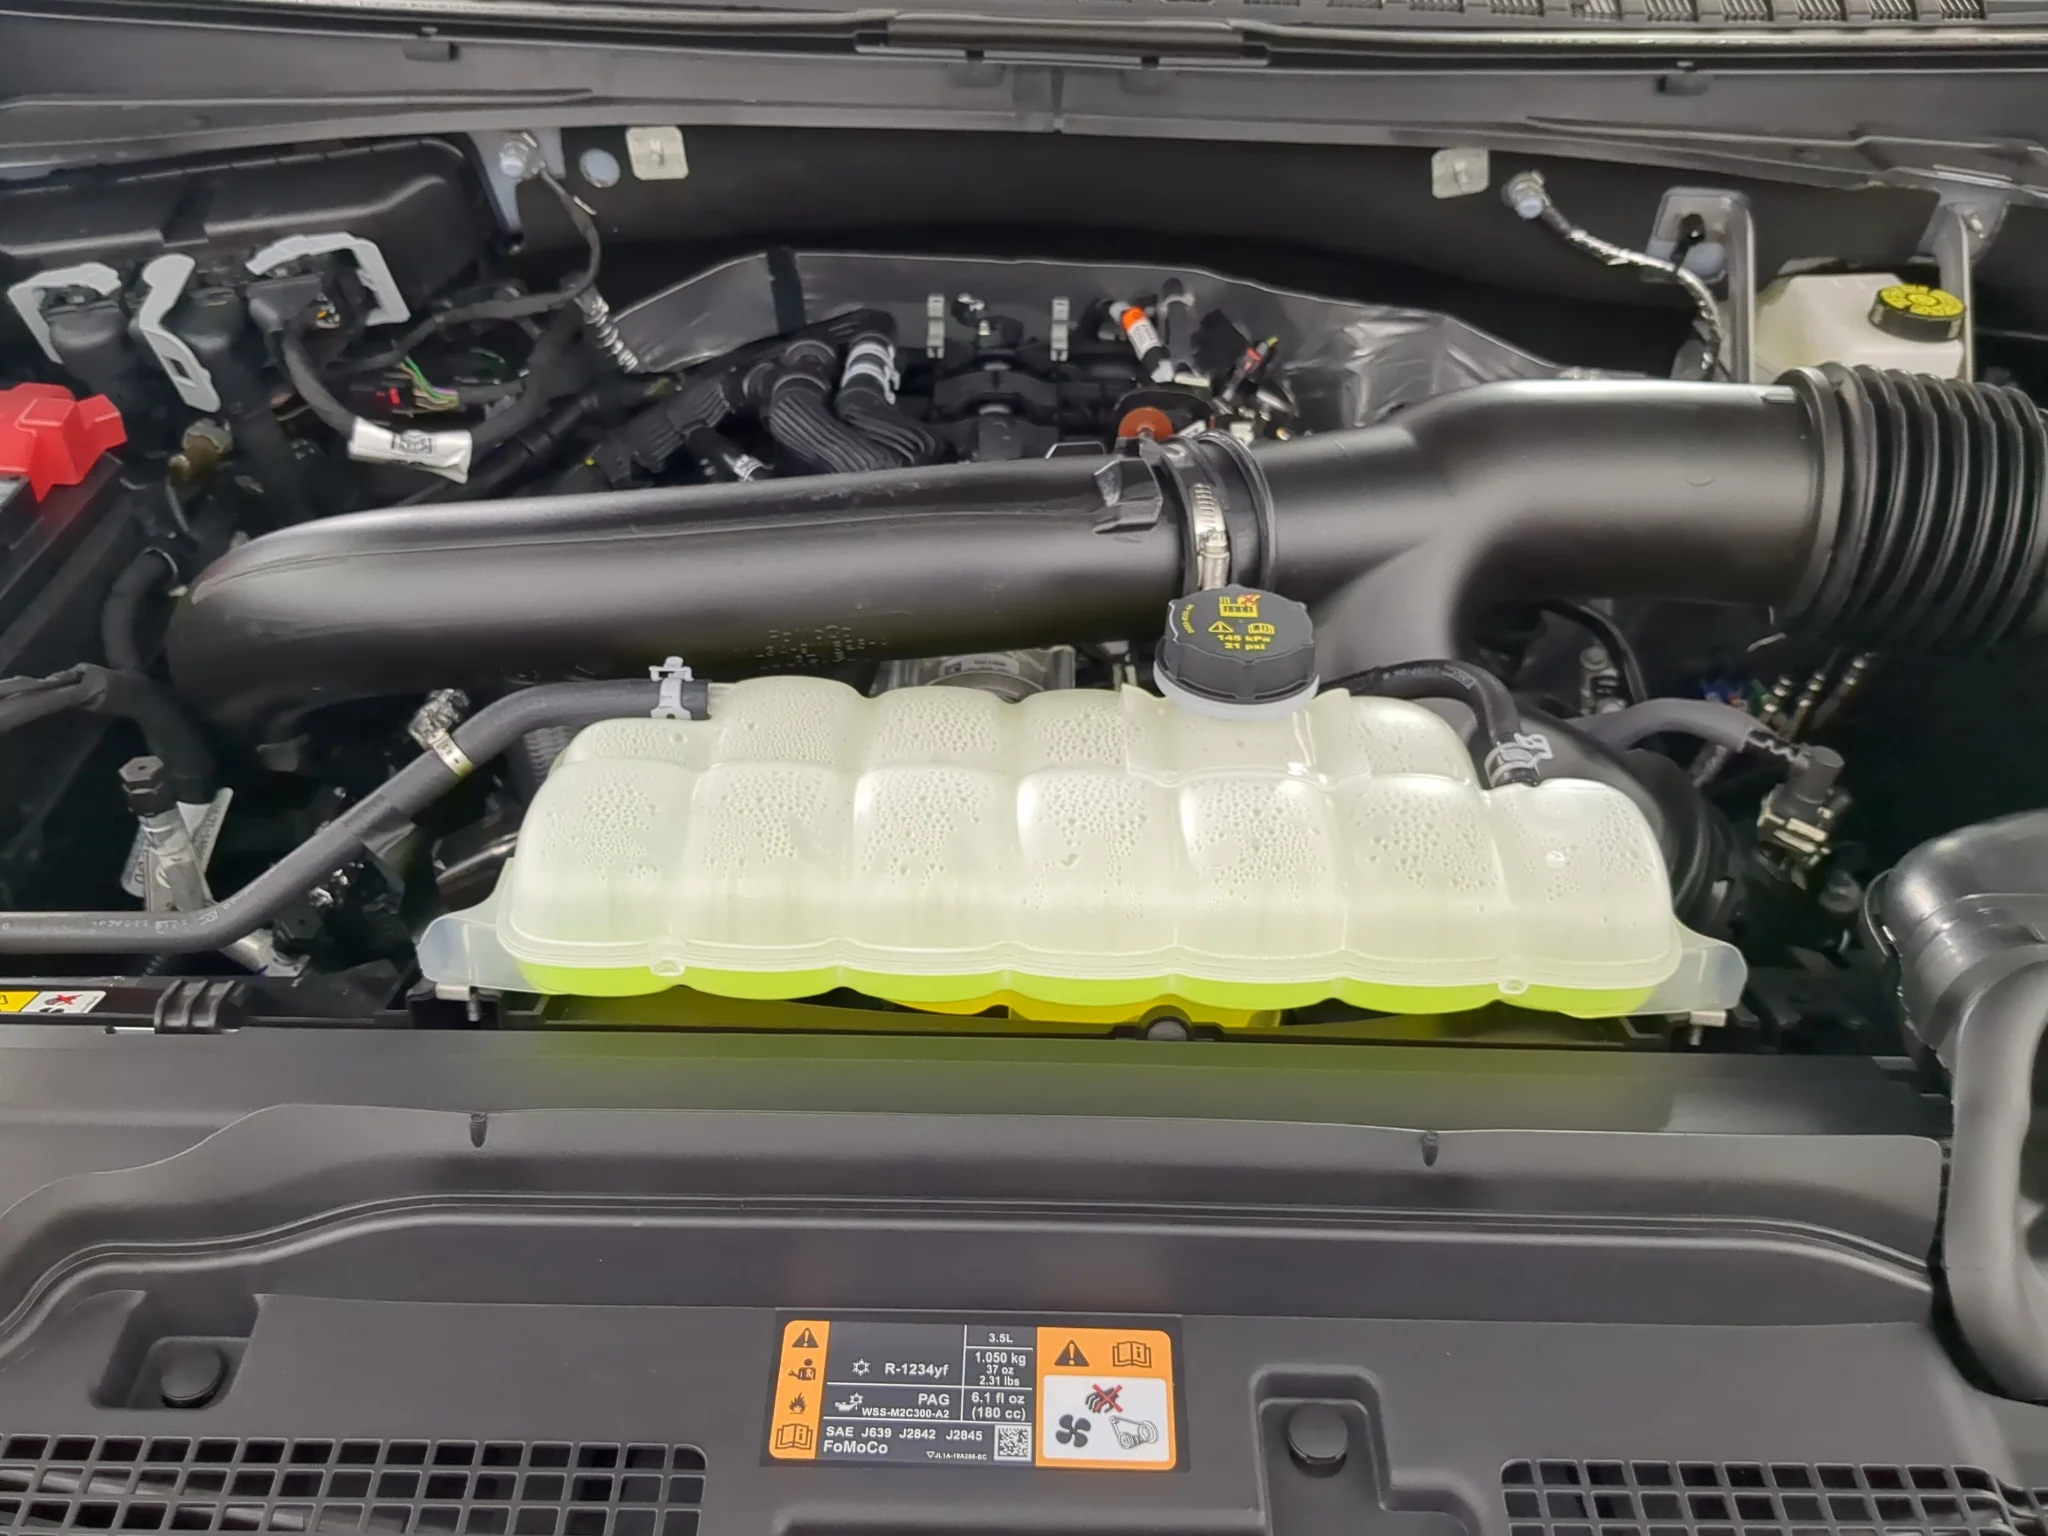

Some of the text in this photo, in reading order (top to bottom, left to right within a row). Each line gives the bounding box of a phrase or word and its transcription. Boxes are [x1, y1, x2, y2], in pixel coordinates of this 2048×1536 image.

[1244, 634, 1271, 643] kPa
[1224, 642, 1266, 651] 21 psi
[988, 1332, 1014, 1344] 3.5L
[975, 1351, 1027, 1367] 1.050 kg
[884, 1362, 949, 1379] R-1234yf
[986, 1364, 1014, 1375] 37 oz
[979, 1375, 1020, 1387] 2.31 lbs
[917, 1393, 950, 1406] PAG
[971, 1392, 1026, 1405] 6.1 fl oz
[861, 1407, 950, 1419] WSS-M2C300-A2
[971, 1406, 1027, 1422] (180 cc)
[825, 1426, 984, 1441] SAE J639 J2842 J2845
[823, 1439, 889, 1454] FoMoCo
